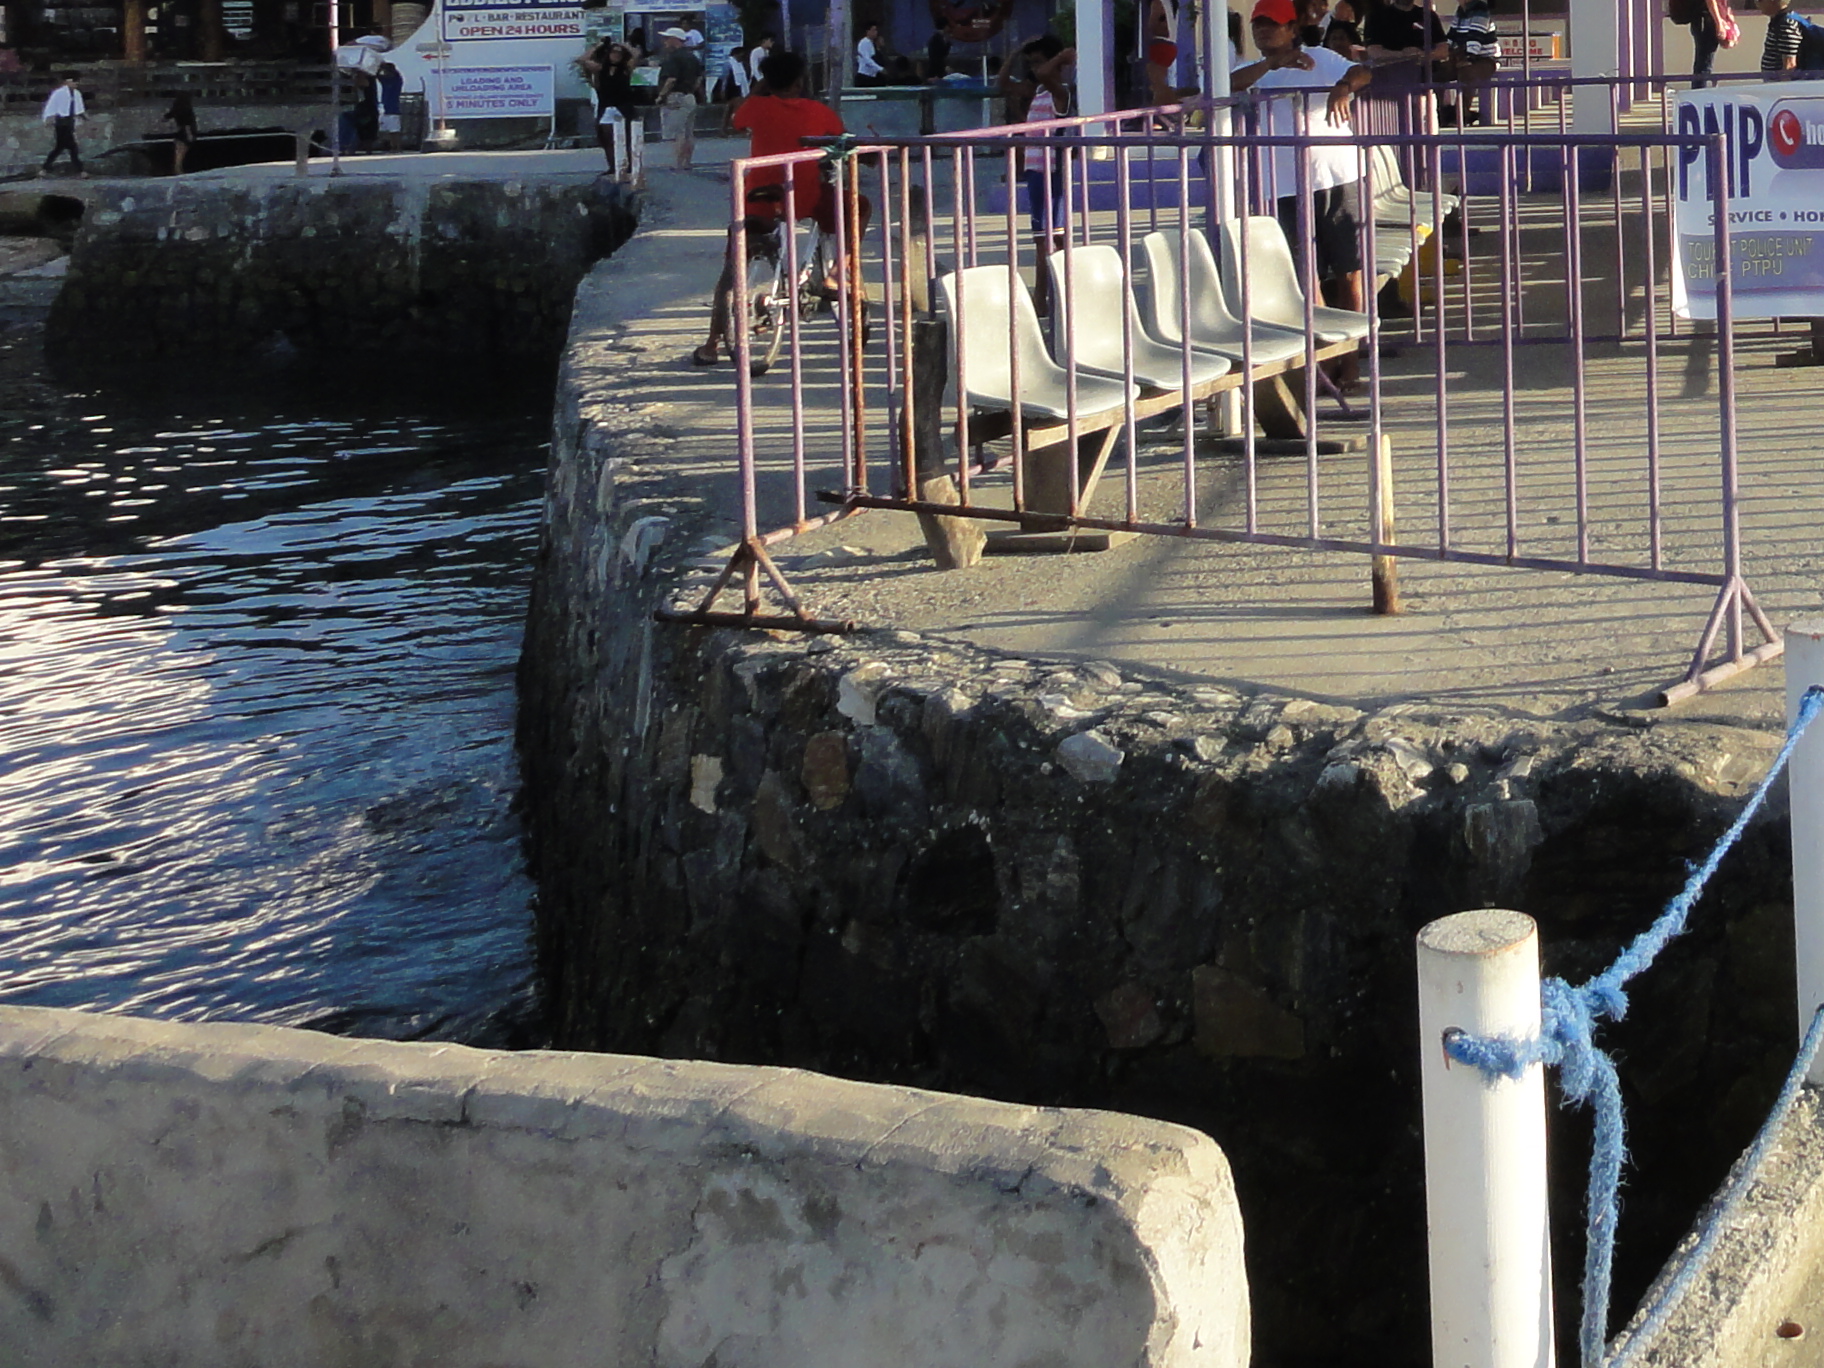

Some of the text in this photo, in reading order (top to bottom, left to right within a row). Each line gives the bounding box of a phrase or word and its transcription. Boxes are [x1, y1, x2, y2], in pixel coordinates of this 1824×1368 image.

[487, 12, 509, 22] BAR
[515, 10, 586, 22] RESTAURANT
[459, 23, 581, 37] OPEN 24 HOURS
[455, 99, 506, 109] MINUTES
[508, 98, 539, 107] ONLY
[1678, 101, 1764, 202] PNP
[1707, 210, 1774, 227] SRVICE
[1740, 237, 1783, 258] POLICE
[1786, 237, 1814, 256] UNIT
